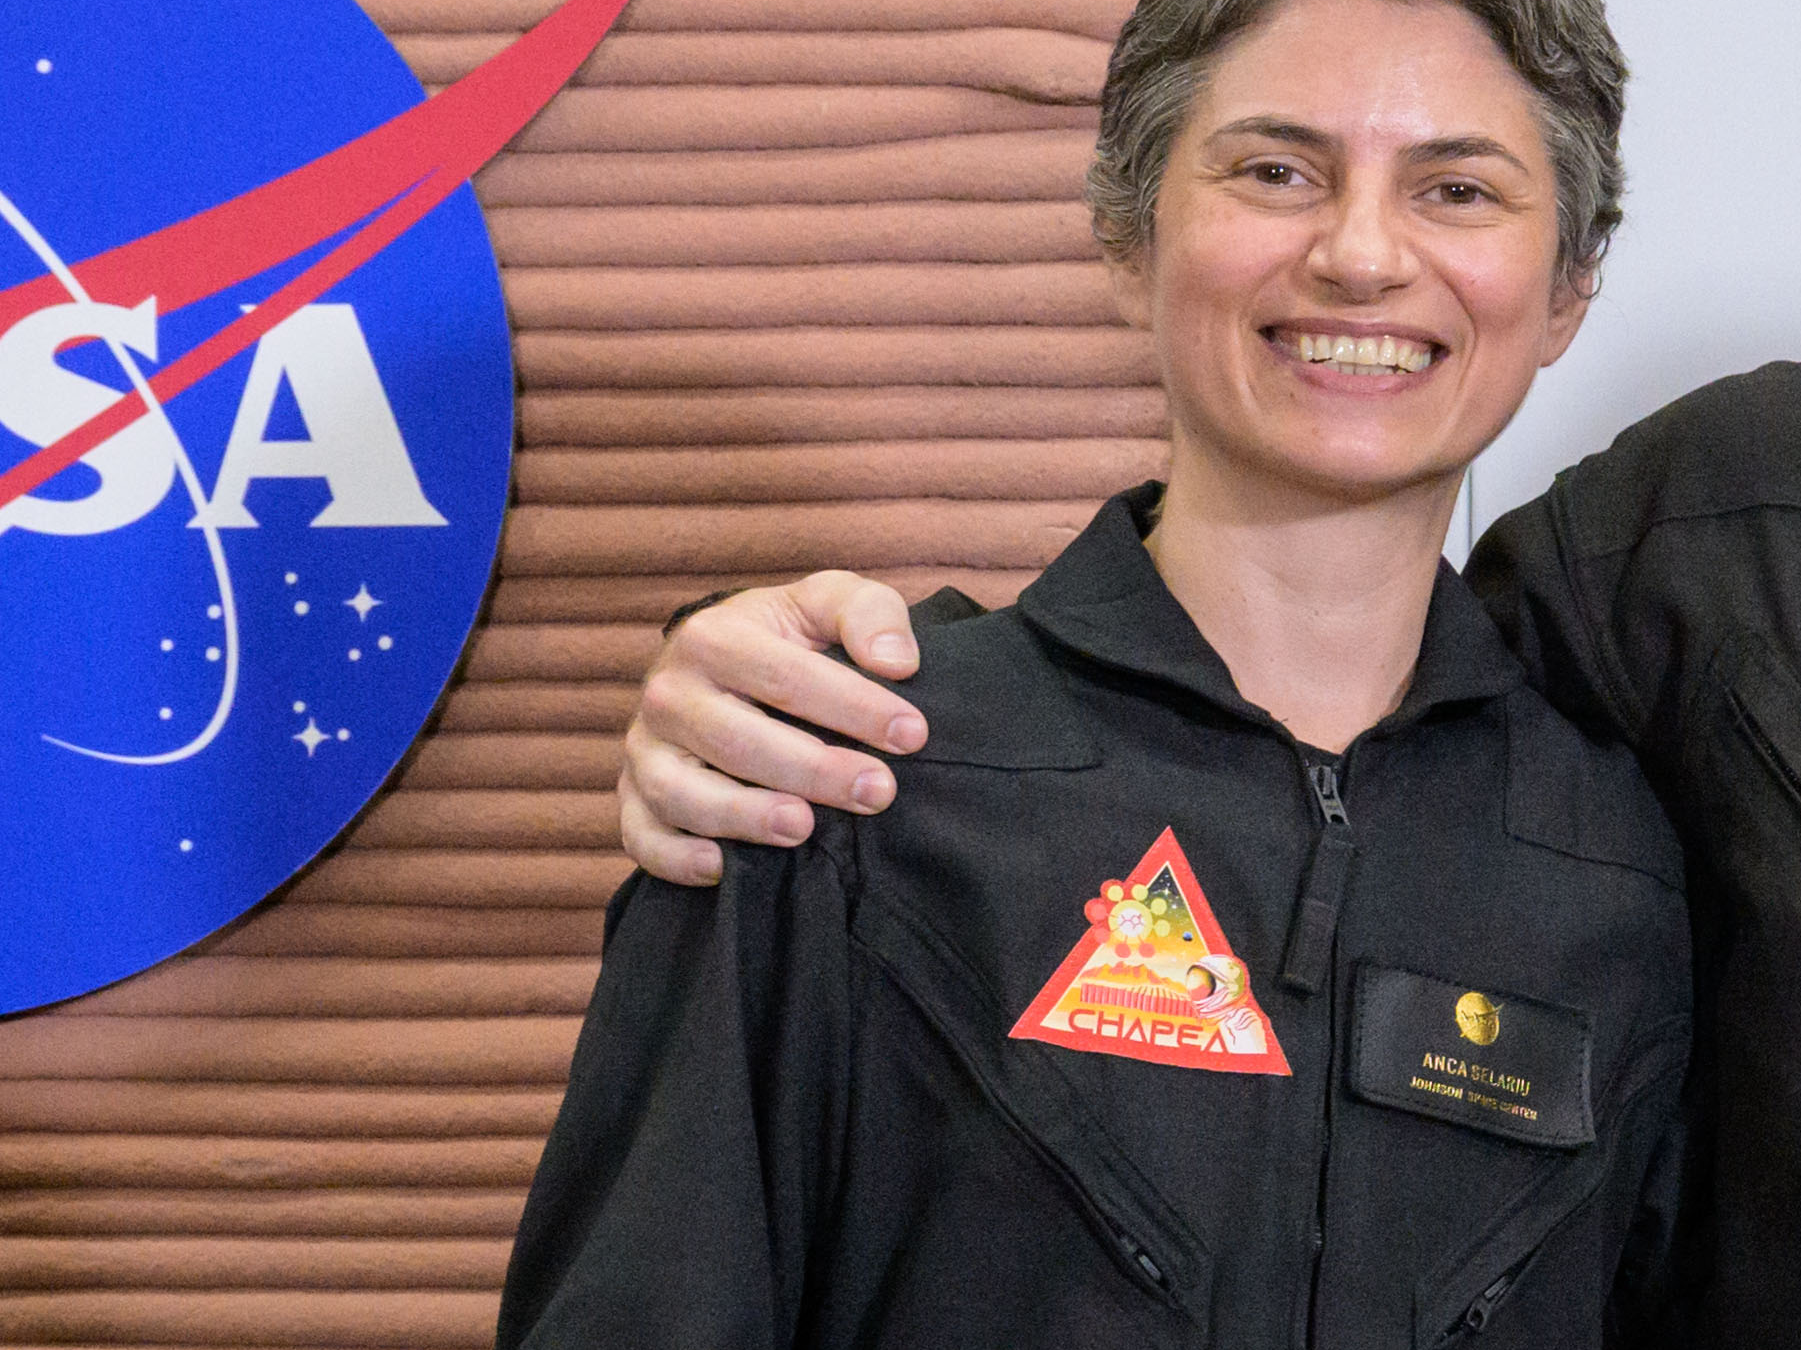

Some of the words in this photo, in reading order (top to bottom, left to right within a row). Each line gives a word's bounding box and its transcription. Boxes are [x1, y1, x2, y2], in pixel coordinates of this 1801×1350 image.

[1068, 1008, 1230, 1054] CHAPEA
[1409, 1075, 1464, 1099] JOHNSON
[1422, 1052, 1468, 1078] ANCA
[1471, 1064, 1530, 1096] SELARIU
